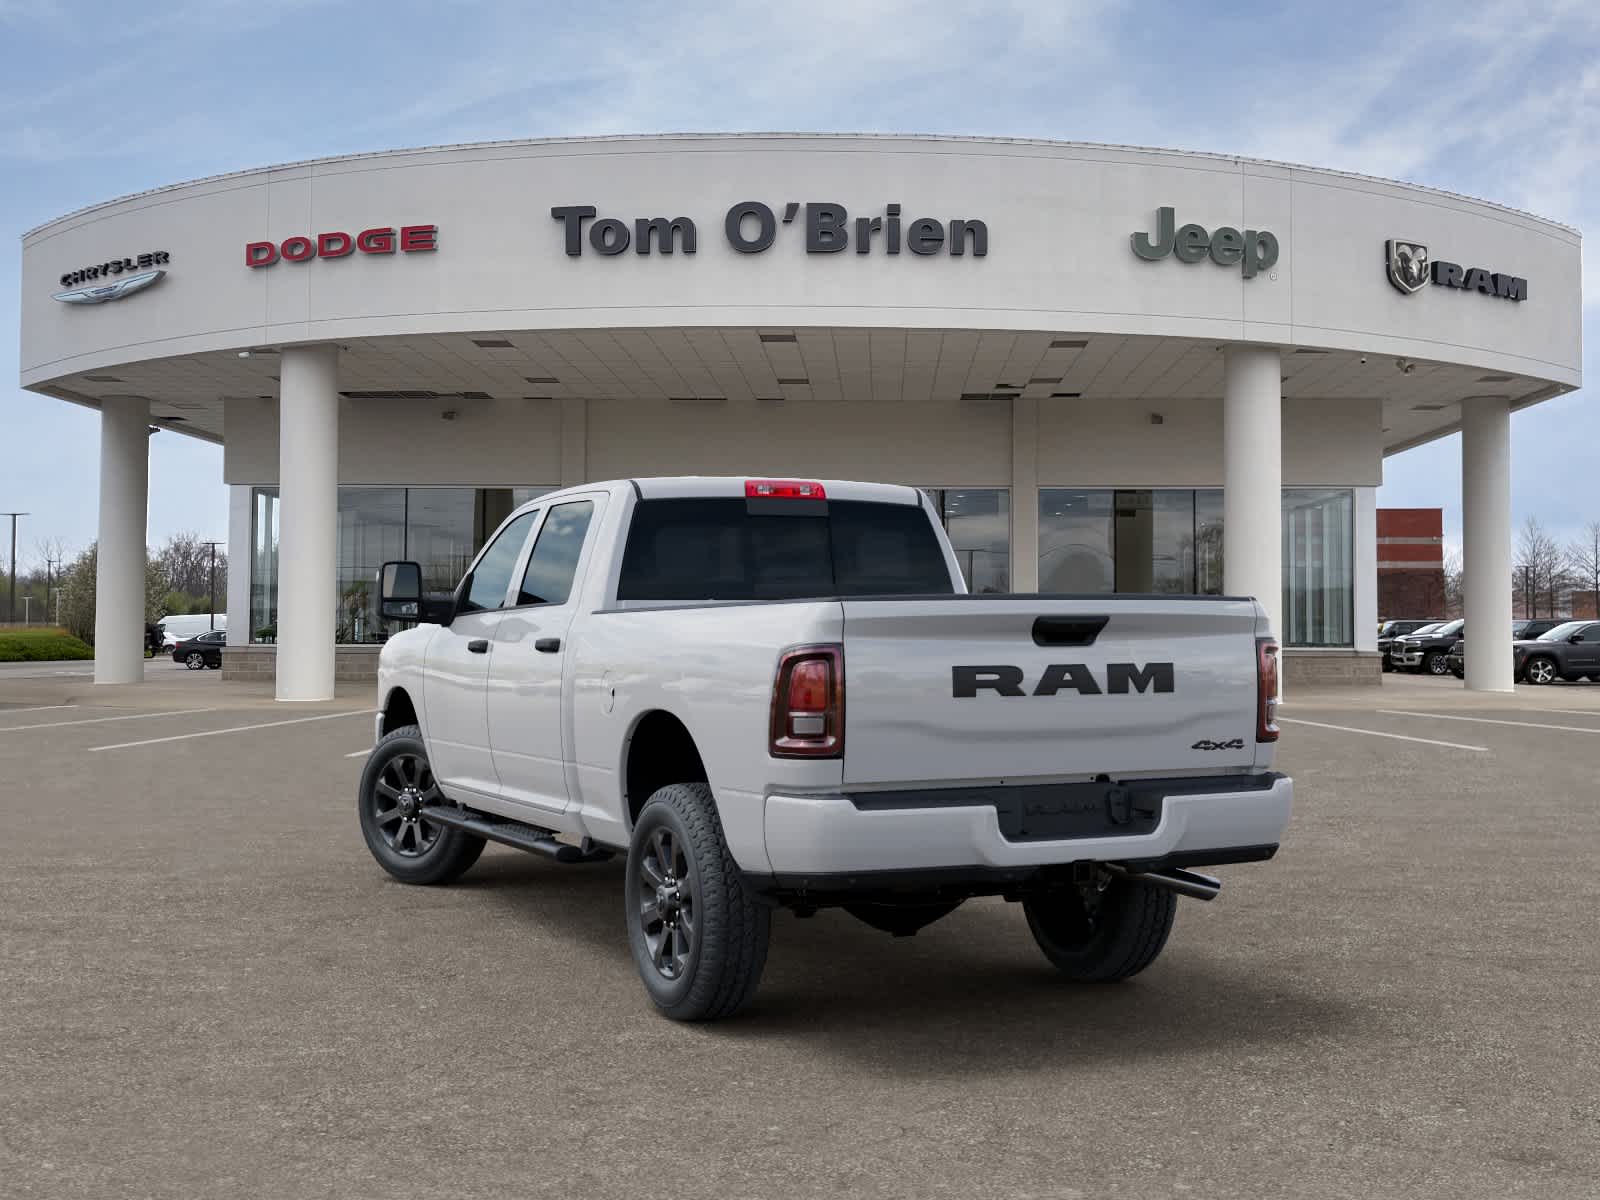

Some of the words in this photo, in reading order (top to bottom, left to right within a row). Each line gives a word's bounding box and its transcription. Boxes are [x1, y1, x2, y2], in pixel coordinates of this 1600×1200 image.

[246, 225, 437, 268] DODGE
[551, 206, 697, 256] Tom
[725, 201, 988, 256] O'Brien
[1130, 207, 1279, 279] Jeep
[60, 250, 170, 287] CHRYSLER
[1431, 261, 1528, 301] RAM
[952, 662, 1175, 698] RAM
[1191, 738, 1245, 751] 4x4
